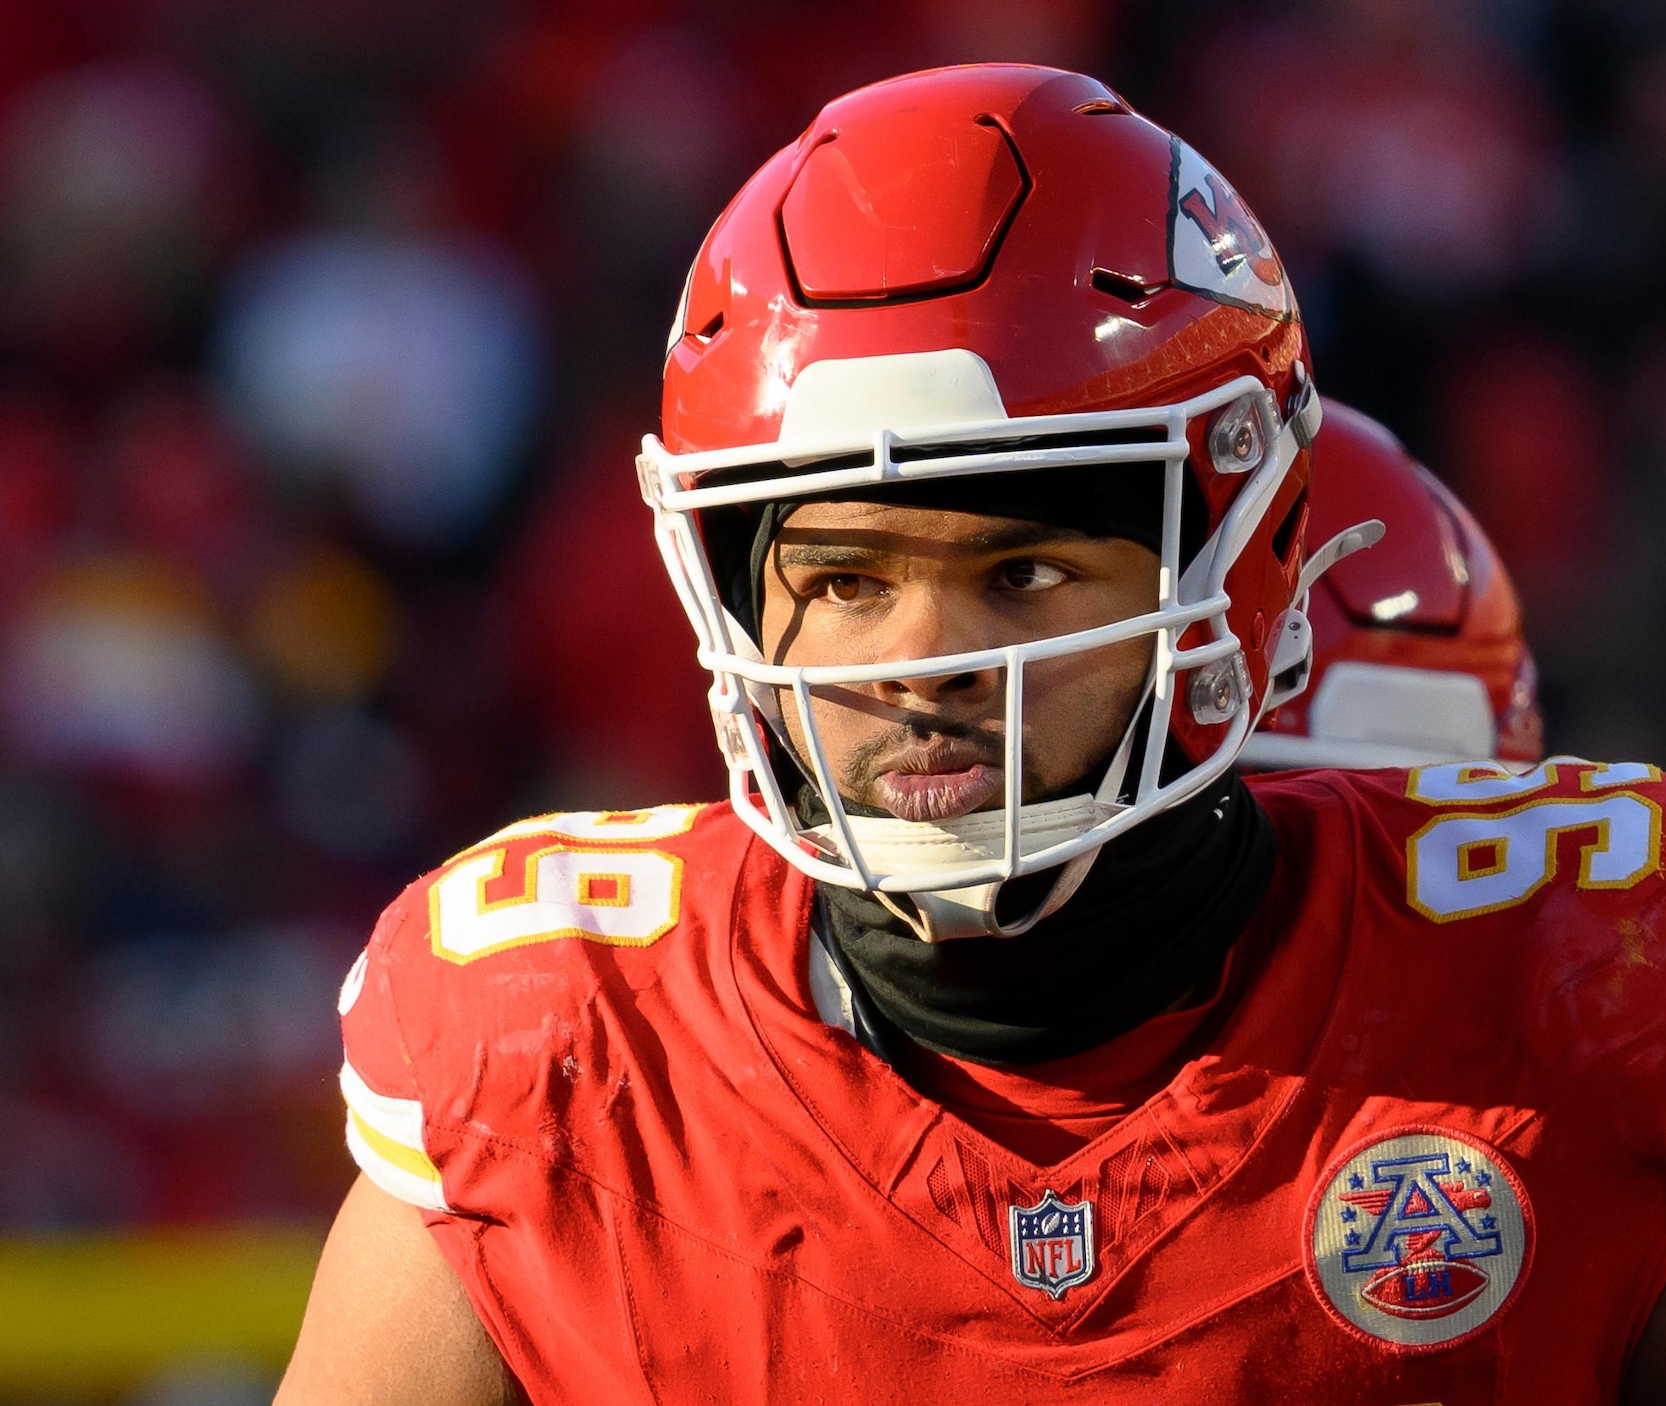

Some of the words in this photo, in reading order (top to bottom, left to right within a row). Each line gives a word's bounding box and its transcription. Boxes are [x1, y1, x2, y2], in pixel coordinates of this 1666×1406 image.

[1342, 1153, 1503, 1273] A
[1025, 1238, 1081, 1280] NFL
[1403, 1272, 1453, 1301] LH
